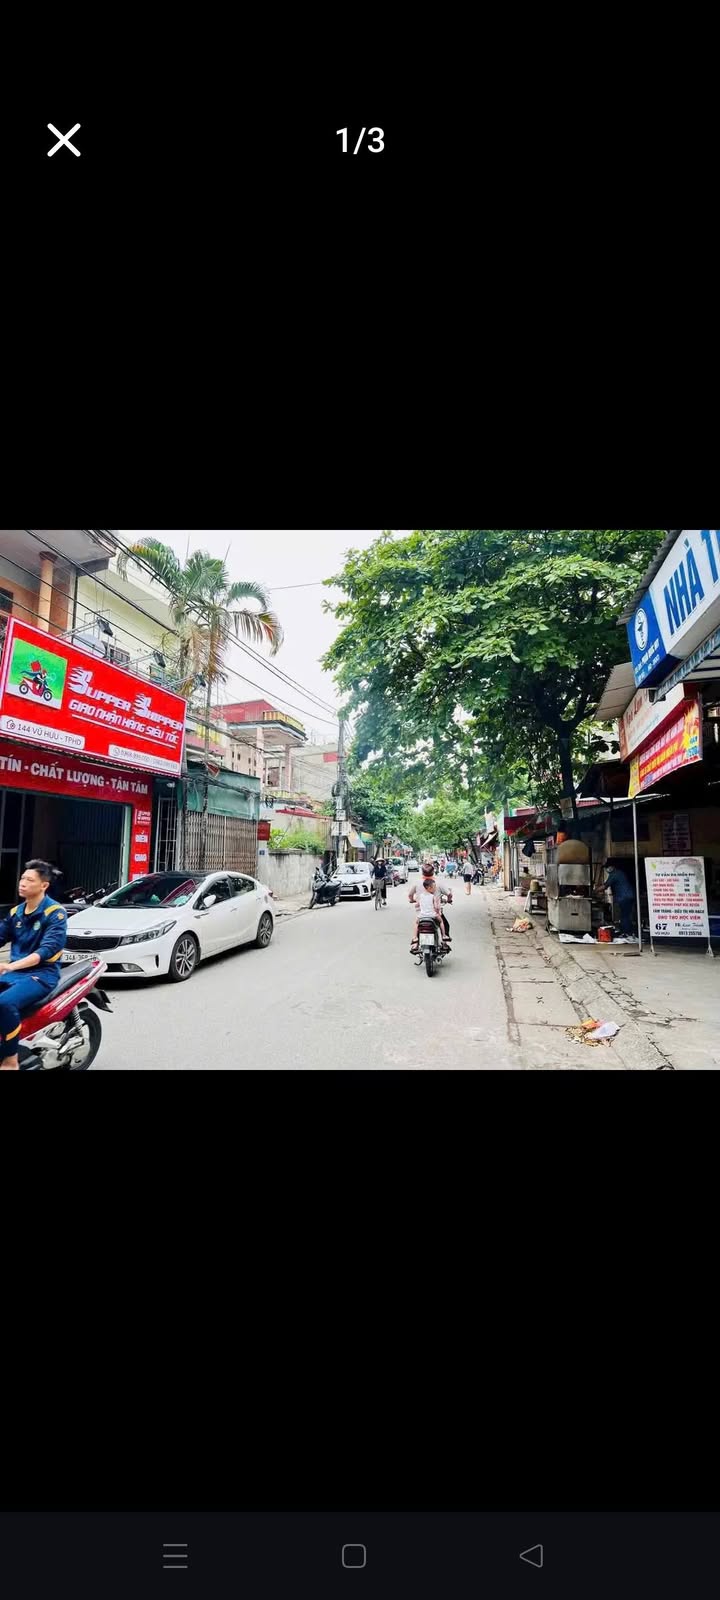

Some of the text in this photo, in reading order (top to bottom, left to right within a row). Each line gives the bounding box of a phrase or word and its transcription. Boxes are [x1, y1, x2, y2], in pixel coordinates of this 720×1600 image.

[663, 530, 720, 635] NHÀ T
[68, 666, 183, 731] SUPPER SHIPPER
[68, 699, 96, 717] GIAO
[0, 754, 148, 795] TÍN CHẤT LƯỢNG TẬN TÂM
[655, 923, 668, 931] 67
